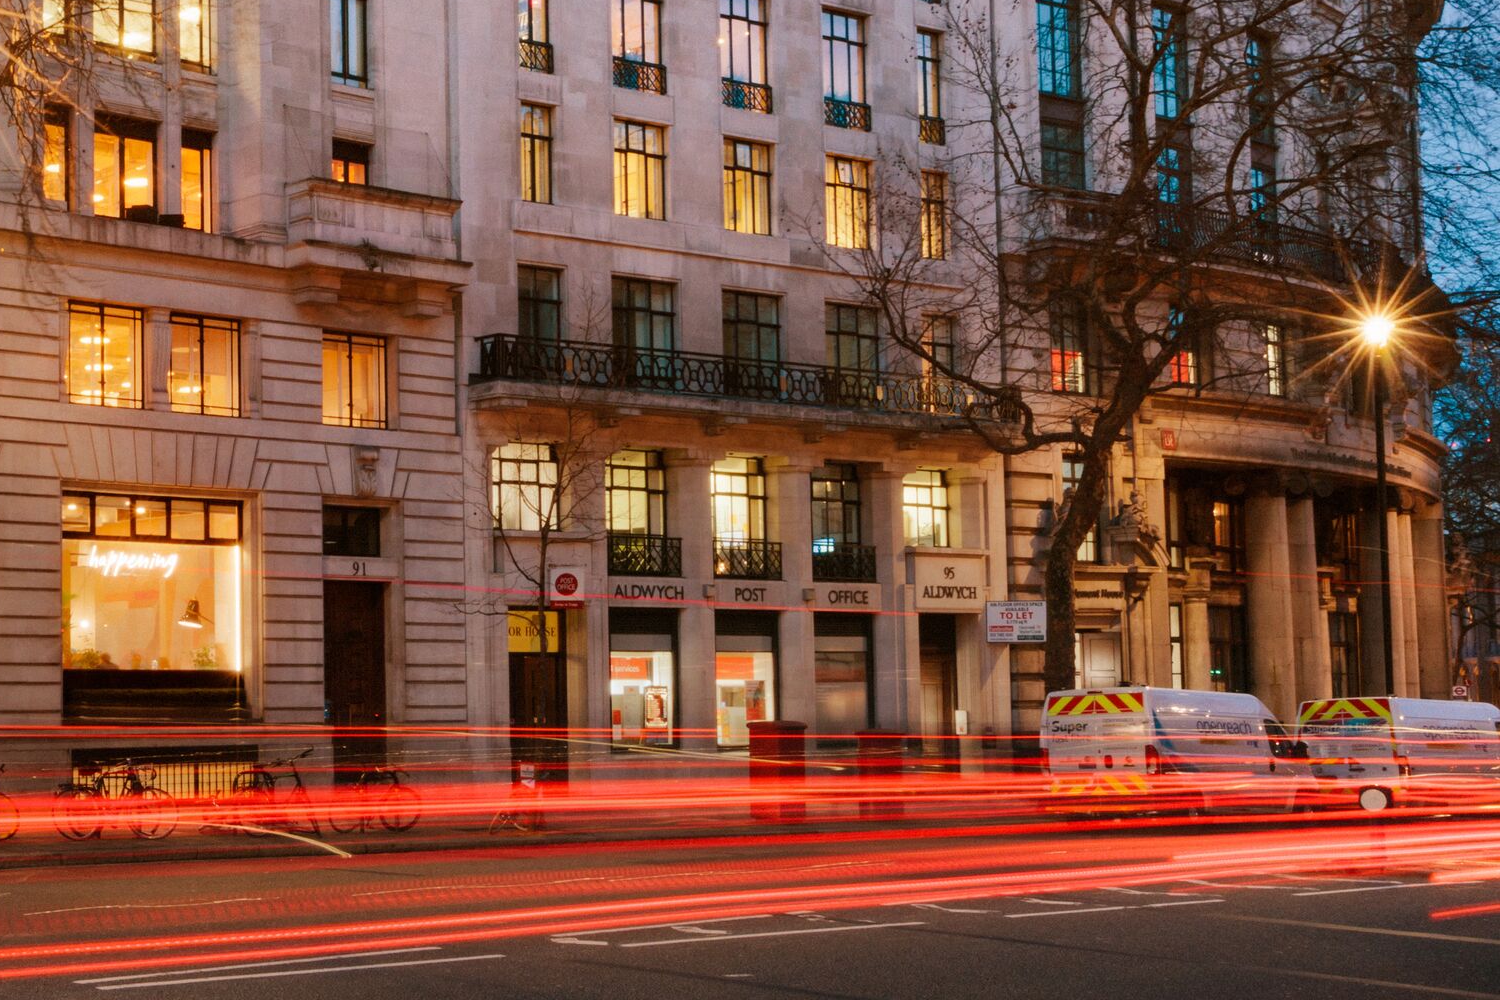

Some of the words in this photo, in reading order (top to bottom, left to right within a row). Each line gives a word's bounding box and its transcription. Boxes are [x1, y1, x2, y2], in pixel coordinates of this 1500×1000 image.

[88, 544, 179, 578] happening
[352, 560, 366, 576] 91
[943, 566, 955, 579] 95
[557, 583, 576, 591] OFFICE
[614, 583, 685, 600] ALDWYCH
[734, 587, 767, 602] POST
[827, 589, 869, 605] OFFICE
[923, 585, 978, 600] ALDWYCH
[1000, 611, 1013, 620] TO
[1016, 611, 1034, 620] LET
[525, 626, 556, 637] HOSE
[1051, 720, 1088, 735] Super
